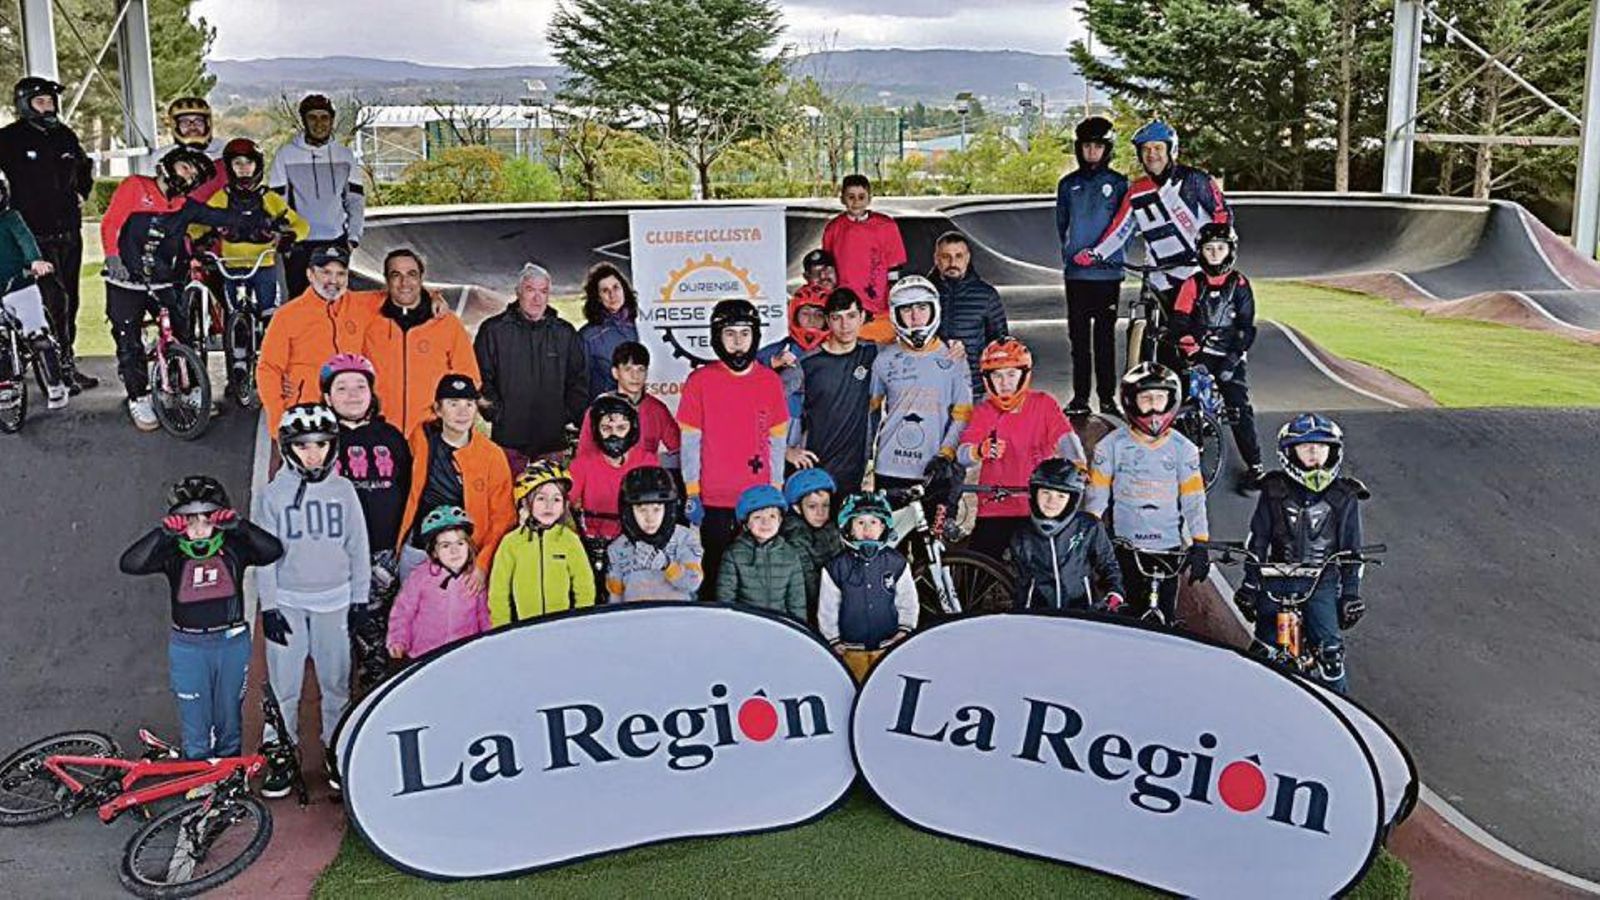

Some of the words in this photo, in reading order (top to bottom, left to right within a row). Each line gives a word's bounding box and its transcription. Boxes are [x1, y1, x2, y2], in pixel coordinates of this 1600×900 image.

[645, 227, 763, 245] CLUBECICLISTA
[679, 280, 740, 293] OURENSE
[638, 306, 706, 321] MAESE
[687, 335, 710, 348] TE
[284, 501, 343, 540] COB
[387, 725, 524, 797] La
[536, 683, 834, 771] Región
[886, 673, 996, 752] La
[1011, 696, 1331, 834] Región
